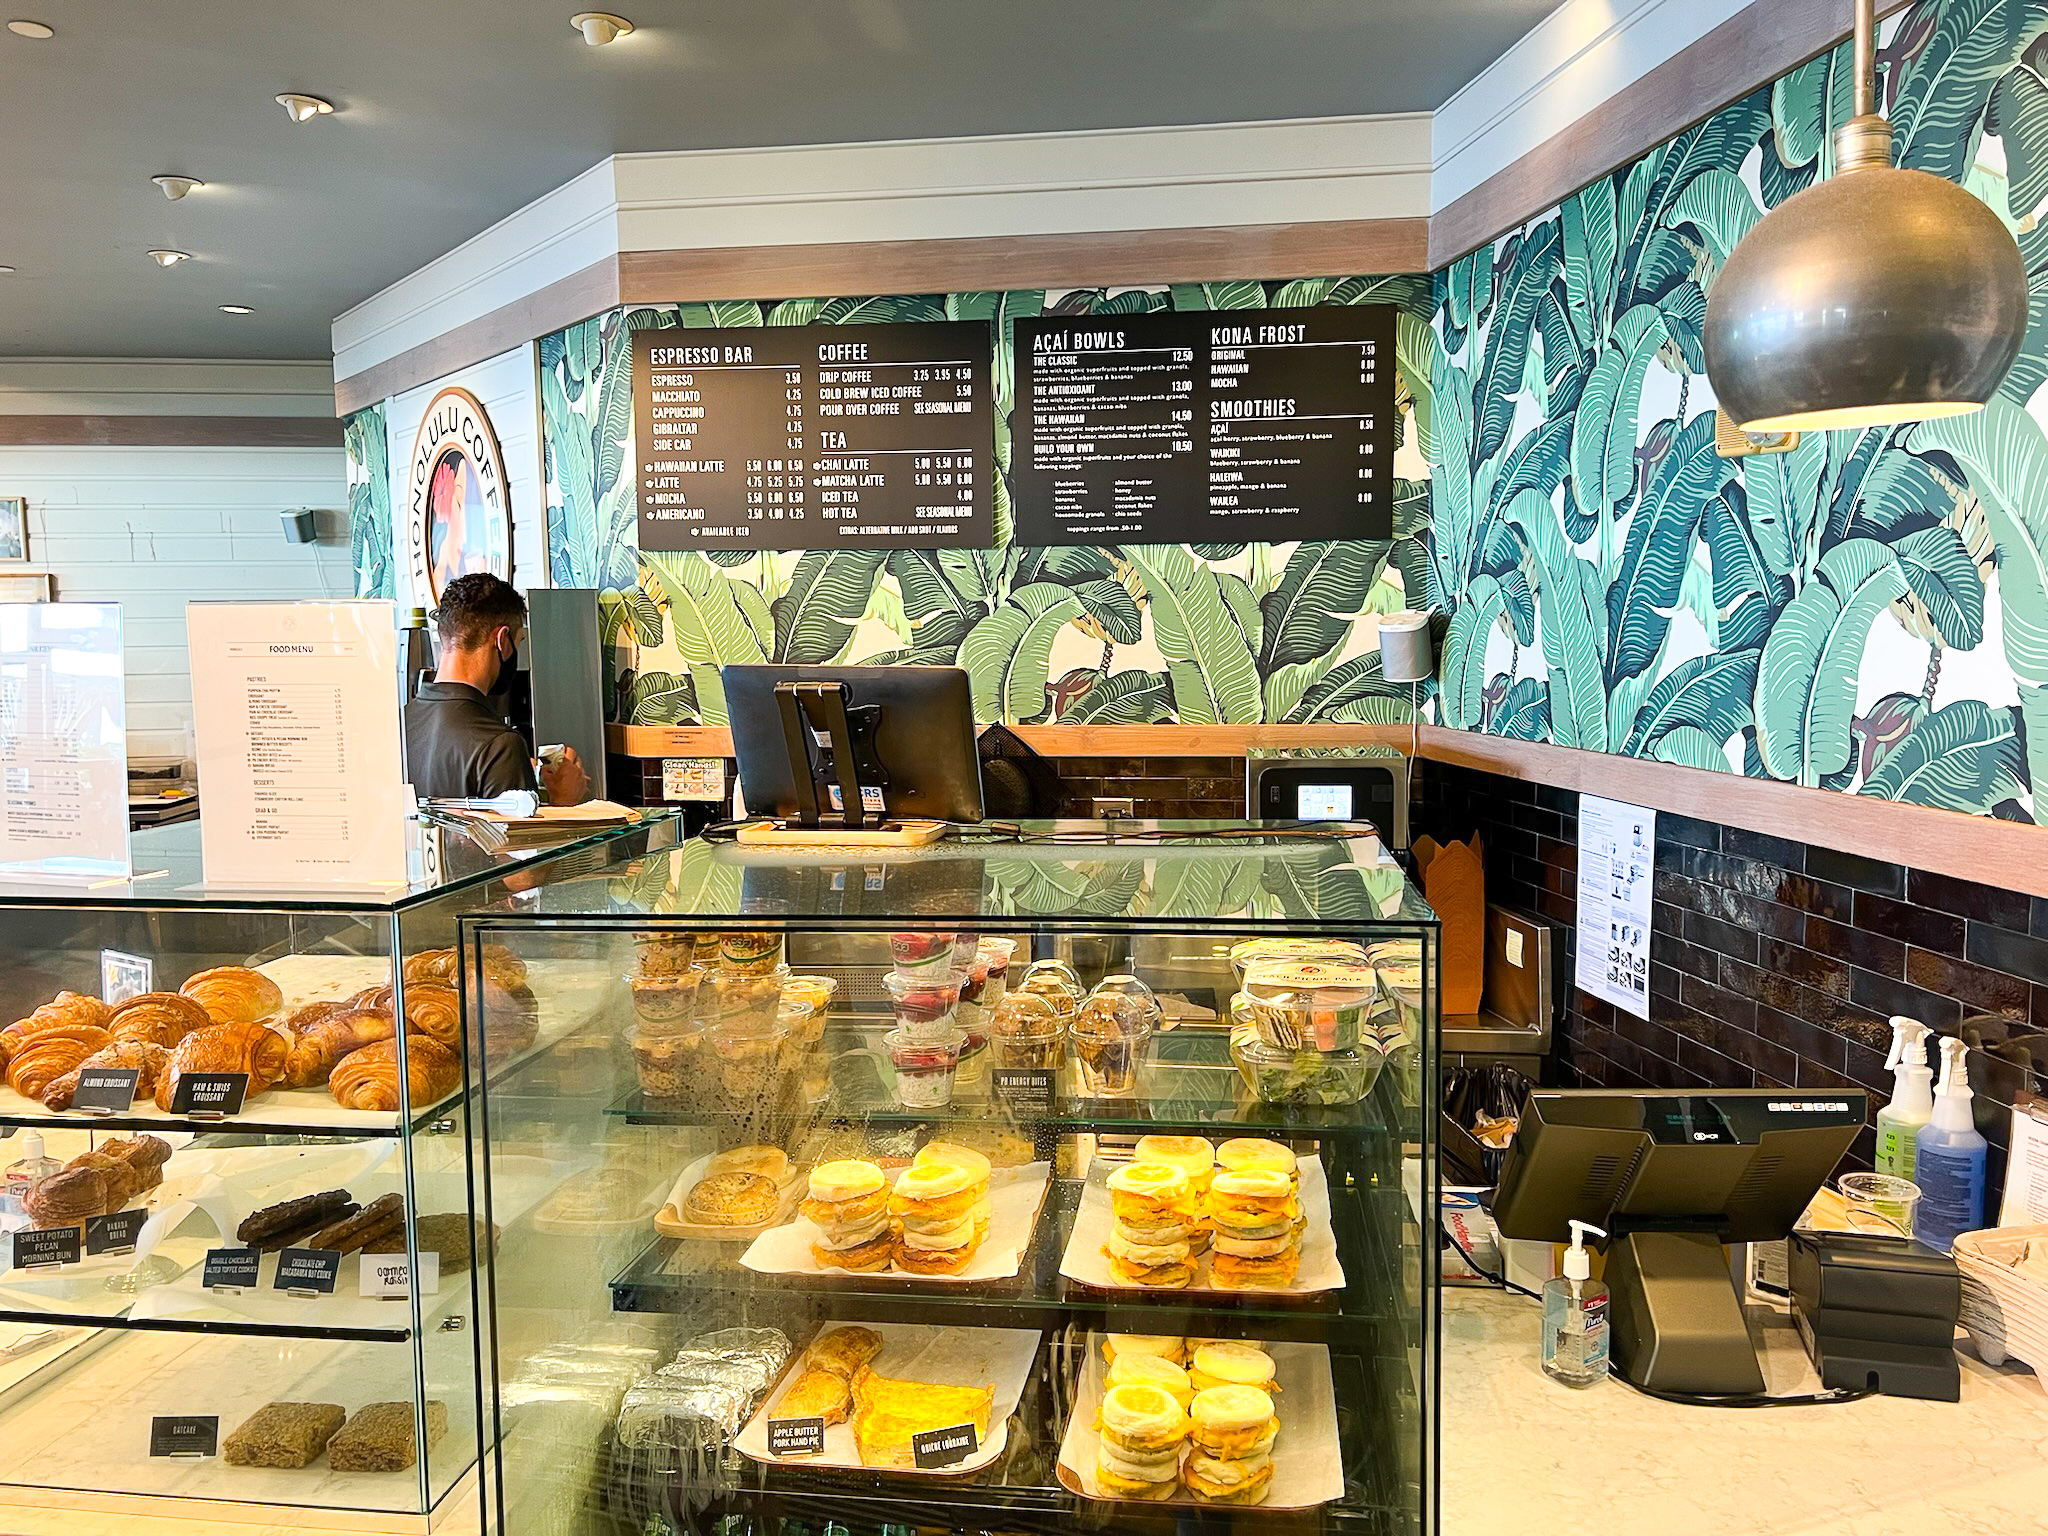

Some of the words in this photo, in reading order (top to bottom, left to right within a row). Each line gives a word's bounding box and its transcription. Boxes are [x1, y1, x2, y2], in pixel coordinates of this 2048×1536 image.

[1033, 330, 1068, 354] AÇAÍ
[1074, 331, 1125, 349] BOWLS
[1211, 327, 1252, 345] KONA
[1259, 325, 1306, 343] FROST
[650, 347, 719, 365] ESPRESSO
[724, 346, 753, 363] BAR
[818, 343, 868, 362] COFFEE
[1033, 357, 1047, 367] THE
[1048, 356, 1078, 366] CLASSIC
[1172, 351, 1194, 362] 12.50
[1211, 350, 1245, 361] ORIGINAL
[819, 371, 839, 384] DRIP
[841, 370, 872, 383] COFFEE
[913, 369, 929, 381] 3.25
[934, 369, 951, 381] 3.95
[955, 368, 972, 380] 4.50
[1064, 367, 1085, 376] organic
[1086, 366, 1118, 375] superfruits
[1130, 365, 1151, 373] topped
[1210, 364, 1250, 375] HAWAIIAN
[651, 374, 694, 387] ESPRESSO
[785, 372, 801, 384] 3.50
[1210, 378, 1238, 388] MOCHA
[819, 387, 842, 400] COLD
[843, 387, 869, 399] BREW
[871, 386, 890, 399] ICED
[891, 385, 922, 398] COFFEE
[956, 384, 972, 397] 5.50
[1033, 386, 1047, 396] THE
[1048, 384, 1096, 395] ANTIOXIDANT
[1171, 380, 1193, 392] 13.00
[651, 390, 701, 403] MACCHIATO
[785, 388, 802, 401] 4.25
[652, 406, 705, 419] CAPPUCCINO
[785, 404, 802, 417] 4.75
[820, 404, 843, 416] POUR
[845, 403, 868, 416] OVER
[869, 402, 900, 415] COFFEE
[1210, 399, 1296, 418] SMOOTHIES
[1033, 415, 1047, 425] THE
[1048, 414, 1085, 424] HAWAIIAN
[1171, 410, 1193, 421] 14.50
[652, 422, 698, 435] GIBRALTAR
[786, 421, 803, 433] 4.75
[1210, 422, 1229, 436] AÇAÍ
[653, 439, 673, 451] SIDE
[674, 438, 692, 451] CAR
[786, 437, 803, 449] 4.75
[820, 431, 847, 449] TEA
[1033, 444, 1055, 454] BUILD
[1055, 443, 1075, 454] YOUR
[1076, 443, 1095, 453] OWN
[1171, 441, 1193, 452] 10.50
[654, 460, 698, 473] HAWAIIAN
[699, 460, 725, 472] LATTE
[746, 459, 762, 472] 5.50
[766, 459, 783, 472] 6.00
[787, 459, 804, 472] 6.50
[821, 458, 842, 471] CHAI
[844, 458, 870, 470] LATTE
[914, 457, 931, 470] 5.00
[935, 457, 952, 469] 5.50
[956, 456, 973, 469] 6.00
[654, 476, 680, 489] LATTE
[746, 475, 763, 488] 4.75
[767, 475, 783, 488] 5.25
[787, 475, 804, 488] 5.75
[821, 475, 858, 487] MATCHA
[859, 474, 885, 487] LATTE
[914, 474, 931, 486] 5.00
[935, 473, 952, 486] 5.50
[956, 473, 973, 485] 6.00
[413, 406, 458, 577] HONOLULU
[463, 416, 501, 577] COFFEE
[654, 492, 686, 505] MOCHA
[747, 491, 763, 504] 5.50
[767, 491, 783, 504] 6.00
[788, 491, 804, 504] 6.50
[821, 491, 841, 503] ICED
[842, 491, 859, 503] TEA
[957, 489, 973, 502] 4.00
[655, 508, 705, 520] AMERICANO
[747, 507, 764, 520] 3.50
[768, 507, 784, 520] 4.00
[788, 507, 805, 520] 4.25
[822, 507, 840, 519] HOT
[841, 507, 858, 519] TEA
[955, 505, 973, 517] MENU
[701, 526, 734, 537] AVAILABLE
[269, 645, 291, 653] FOOD
[291, 645, 314, 653] MENU
[104, 1078, 131, 1088] CROISSANT
[192, 1083, 206, 1092] HAM
[206, 1083, 211, 1092] &
[212, 1083, 231, 1092] SWISS
[1009, 1076, 1030, 1086] ENERGY
[193, 1092, 225, 1102] CROISSANT
[106, 1221, 128, 1232] BANANA
[20, 1233, 45, 1244] SWEET
[46, 1230, 73, 1241] POTATO
[35, 1242, 59, 1252] PECAN
[22, 1252, 55, 1263] MORNING
[56, 1250, 72, 1259] BUN
[211, 1257, 228, 1265] DOUBLE
[229, 1256, 254, 1265] CHOCOLATE
[292, 1258, 315, 1268] CHOCOLATE
[315, 1259, 326, 1268] CHIP
[205, 1266, 221, 1274] SALTED
[221, 1266, 237, 1274] TOFFEE
[237, 1265, 257, 1274] COOKIES
[172, 1425, 196, 1435] OATCAKE
[773, 1427, 793, 1437] APPLE
[794, 1426, 819, 1436] BUTTER
[773, 1438, 790, 1448] PORK
[790, 1437, 808, 1447] HAND
[809, 1436, 819, 1446] PIE
[920, 1441, 942, 1455] QUICHE
